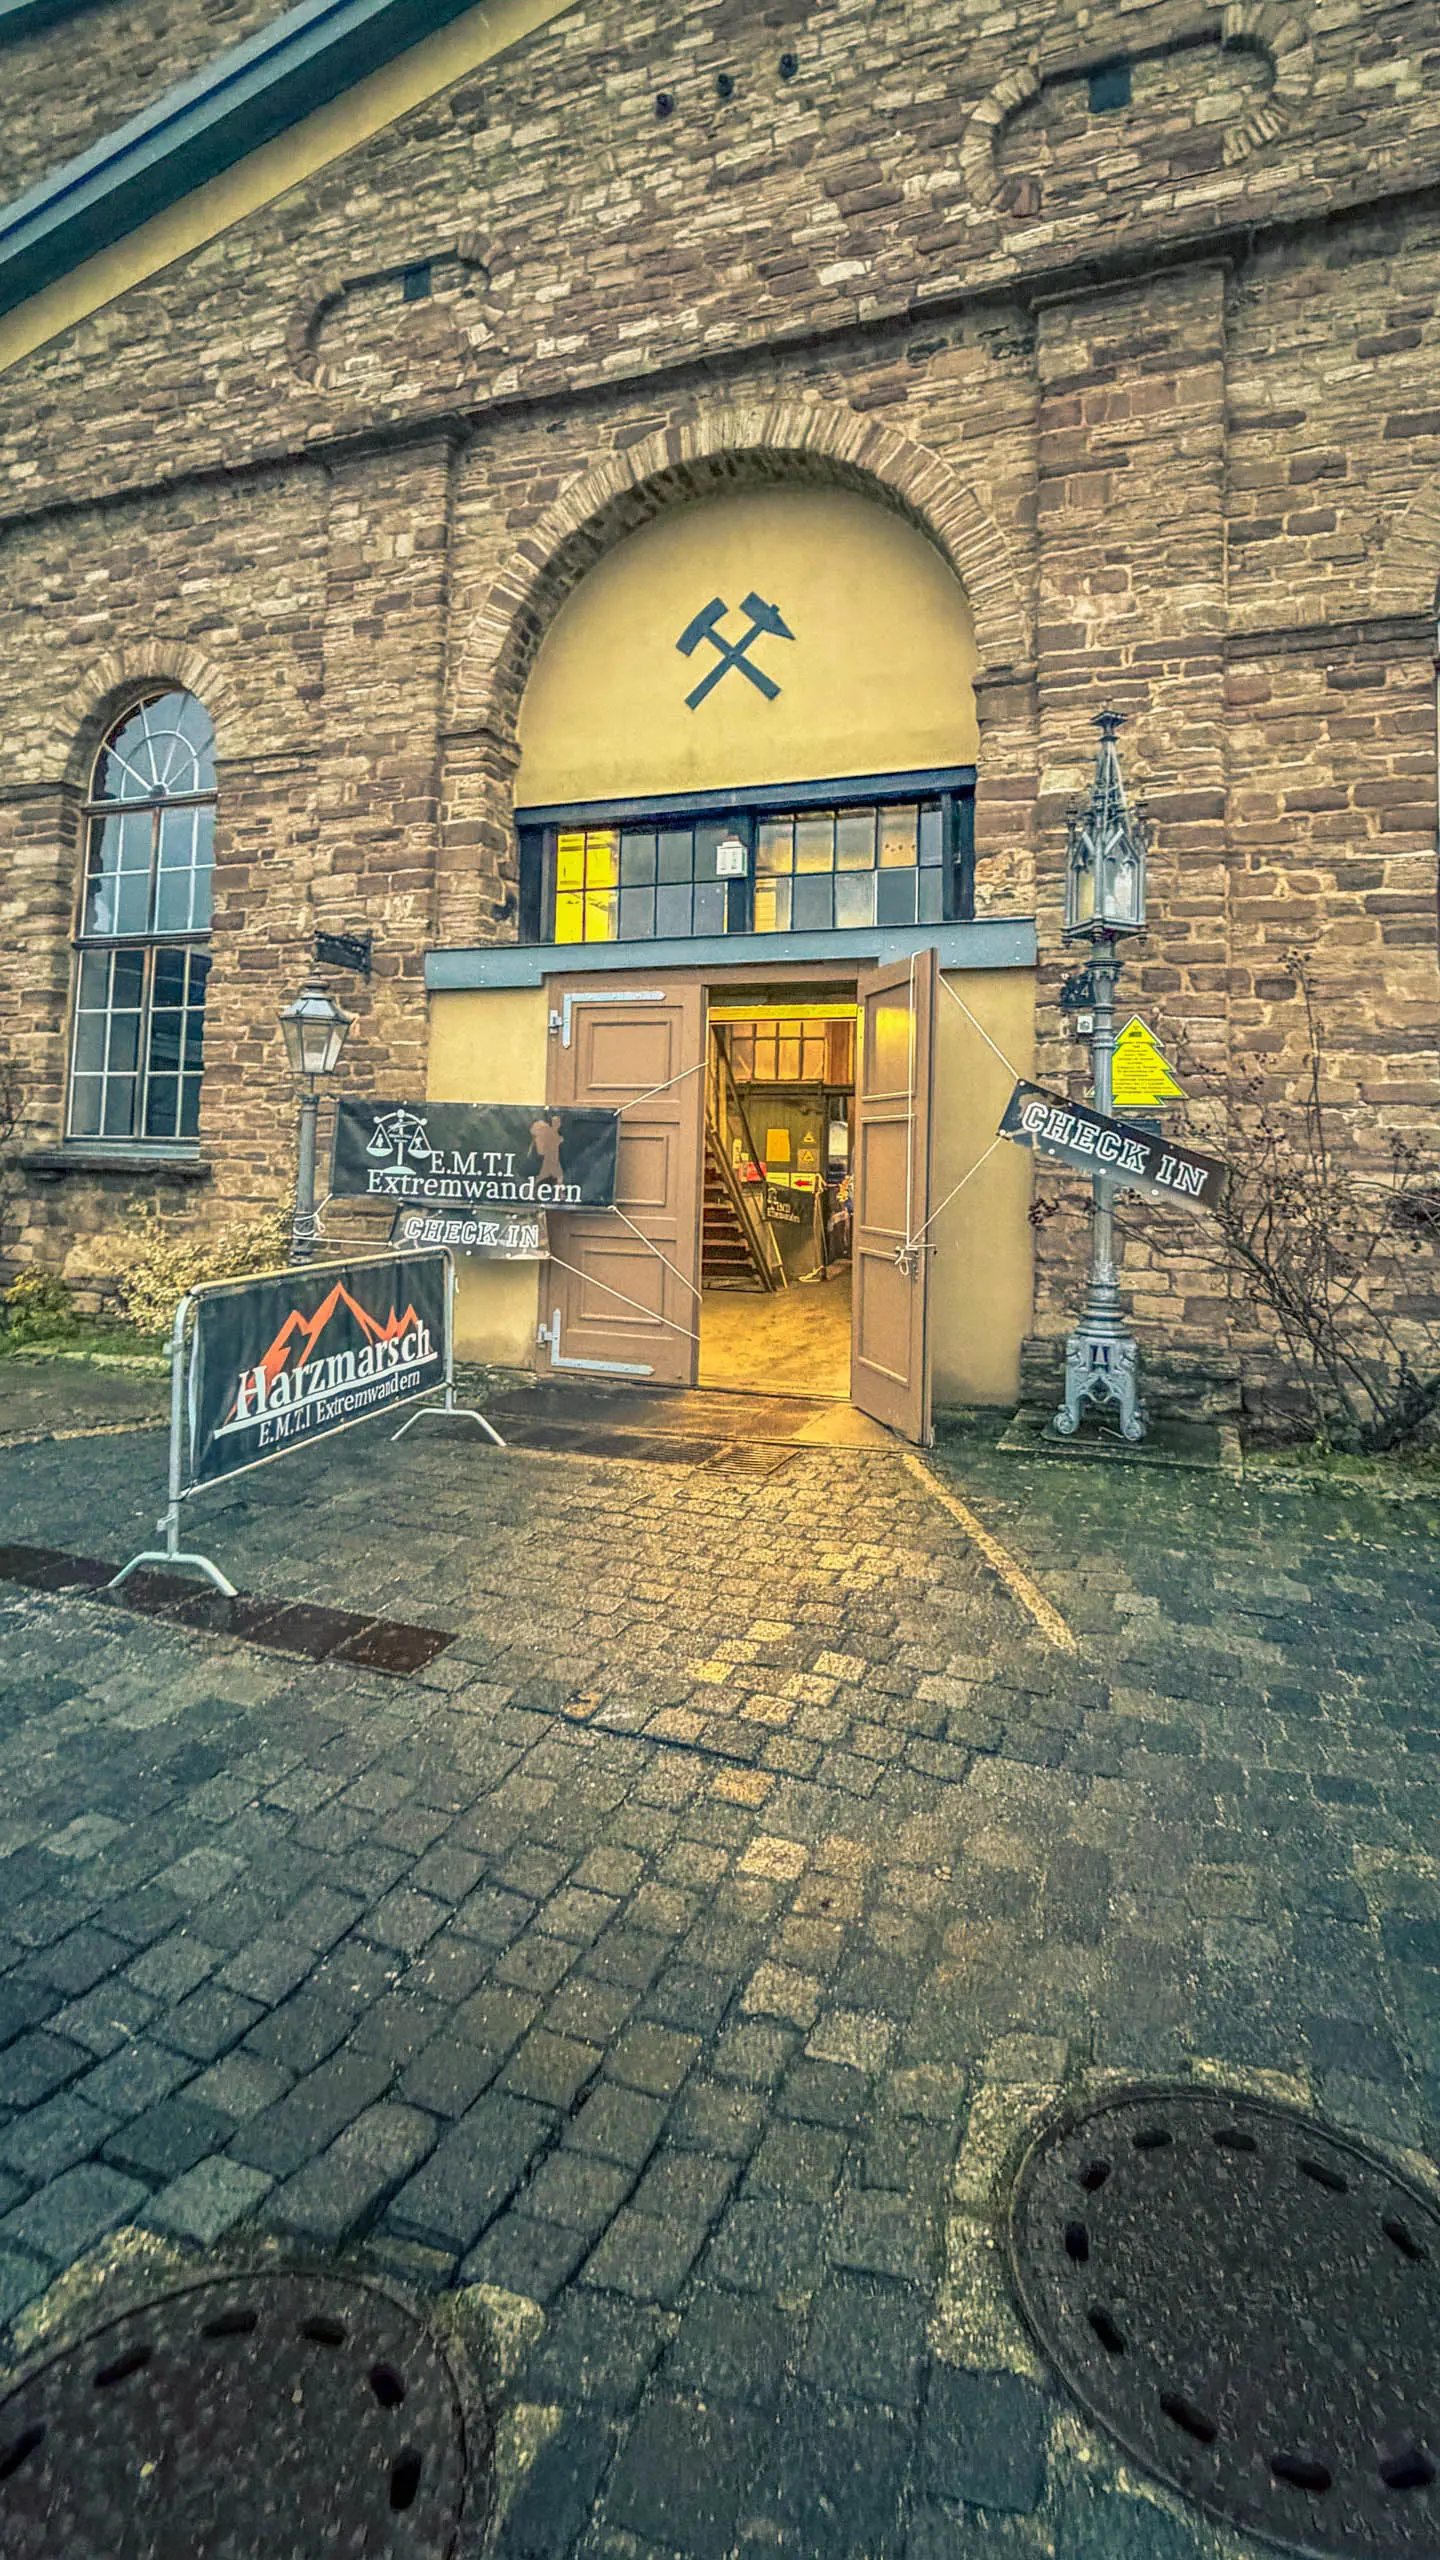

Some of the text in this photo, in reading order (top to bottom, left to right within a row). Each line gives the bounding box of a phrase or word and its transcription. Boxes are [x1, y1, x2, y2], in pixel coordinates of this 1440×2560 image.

[429, 1150, 516, 1177] E.M.T.I
[1021, 1102, 1208, 1196] CHECK IN
[366, 1168, 582, 1203] Extremwandern
[404, 1216, 539, 1249] CHECK IN
[234, 1319, 432, 1422] Harzmarsch
[257, 1370, 421, 1448] E.M.T.I Extremwandern
